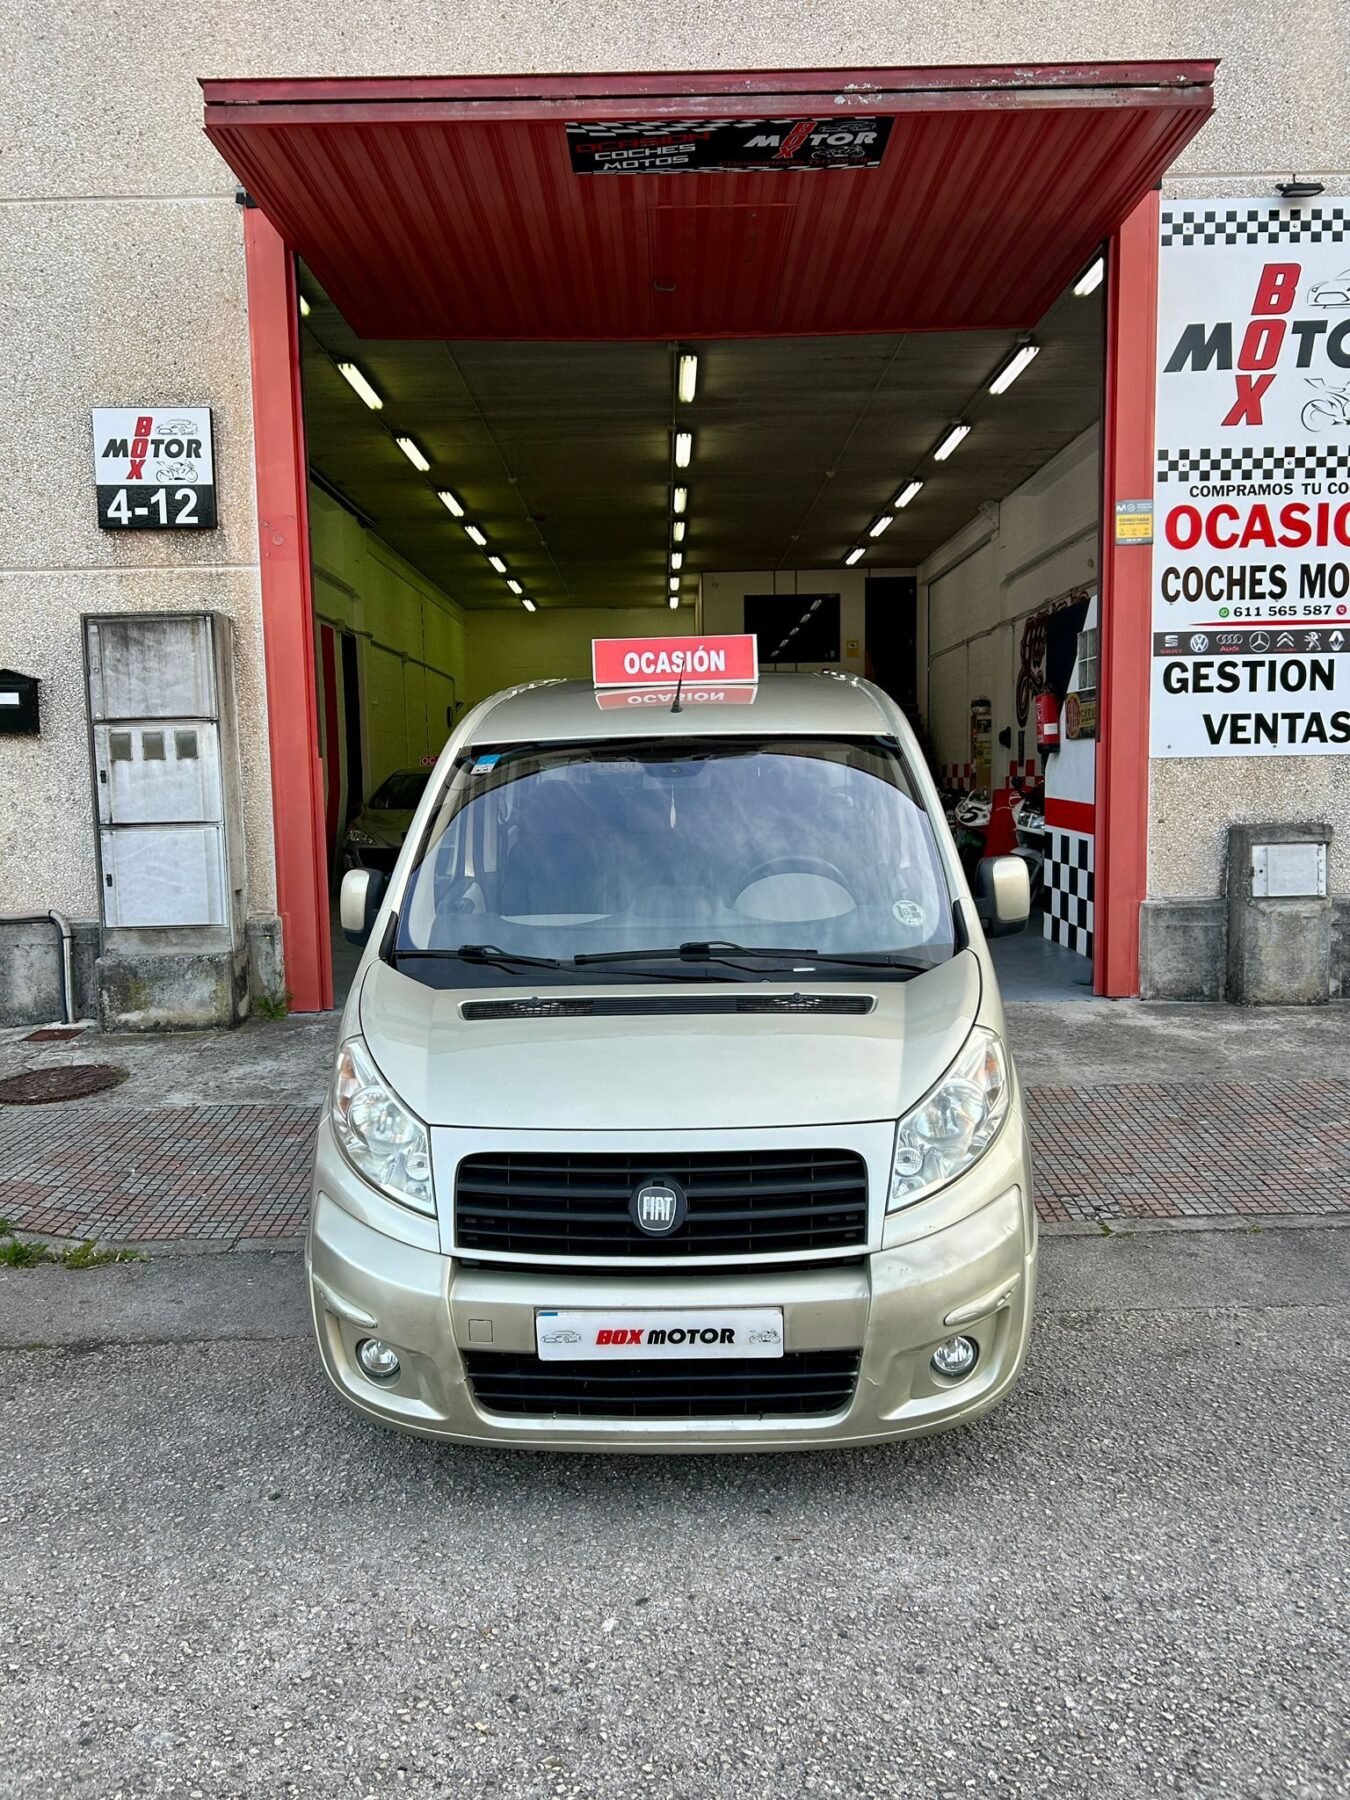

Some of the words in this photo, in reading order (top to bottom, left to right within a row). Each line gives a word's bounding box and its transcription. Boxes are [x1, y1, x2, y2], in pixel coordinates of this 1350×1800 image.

[594, 143, 696, 161] COCHES
[743, 131, 877, 148] MOTOR
[771, 121, 818, 158] BOX
[603, 155, 689, 171] MOTOS
[1221, 263, 1302, 426] BOX
[101, 438, 202, 459] MOTOR
[126, 416, 153, 480] BOX
[1189, 483, 1294, 498] COMPRAMOS
[1301, 482, 1322, 495] TU
[107, 488, 199, 525] 4-12
[1161, 564, 1287, 603] COCHES
[1233, 606, 1262, 617] 611
[1268, 605, 1298, 616] 565
[1303, 604, 1332, 615] 587
[624, 645, 725, 675] OCASIÓN
[1163, 658, 1335, 694] GESTION
[1202, 710, 1350, 745] VENTAS
[643, 1196, 673, 1221] FIAT
[595, 1328, 645, 1345] BOX
[647, 1327, 735, 1345] MOTOR
